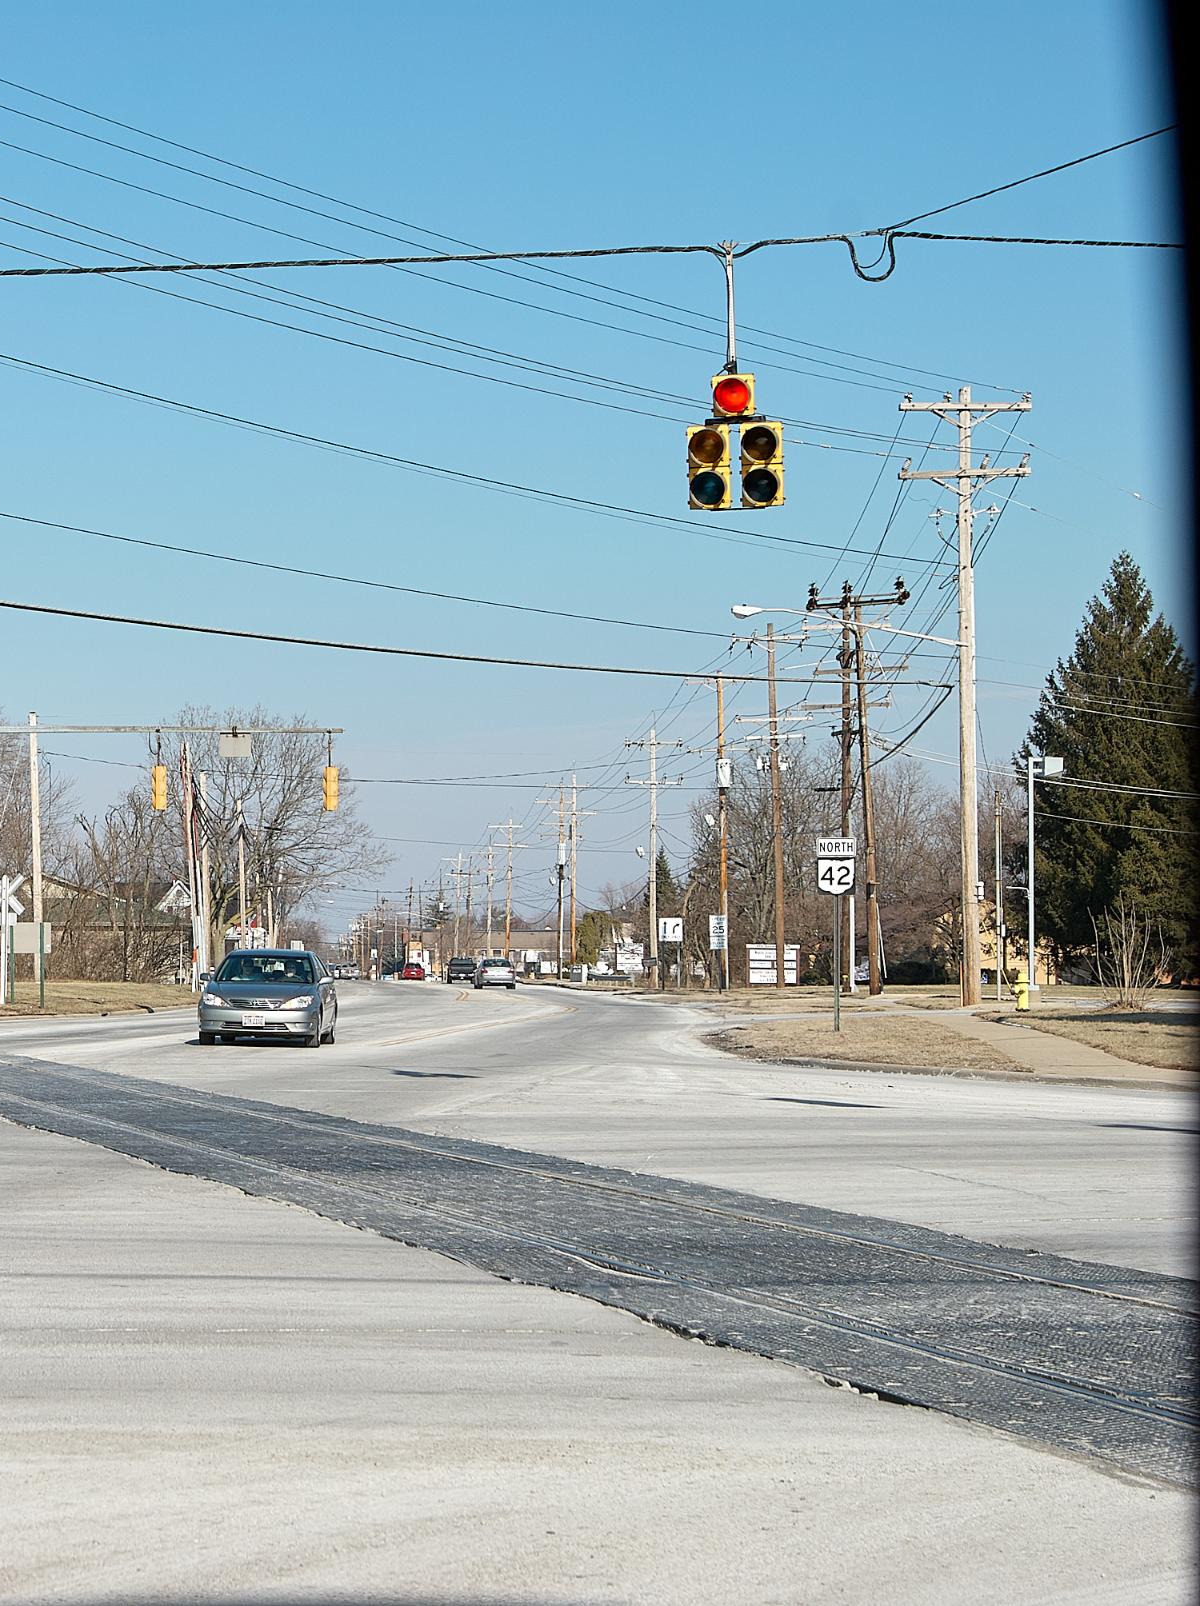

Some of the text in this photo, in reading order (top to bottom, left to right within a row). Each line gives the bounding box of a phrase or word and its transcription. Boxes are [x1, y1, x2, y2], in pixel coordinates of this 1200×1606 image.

[819, 841, 853, 852] NORTH
[820, 866, 850, 885] 42
[712, 926, 725, 934] 25
